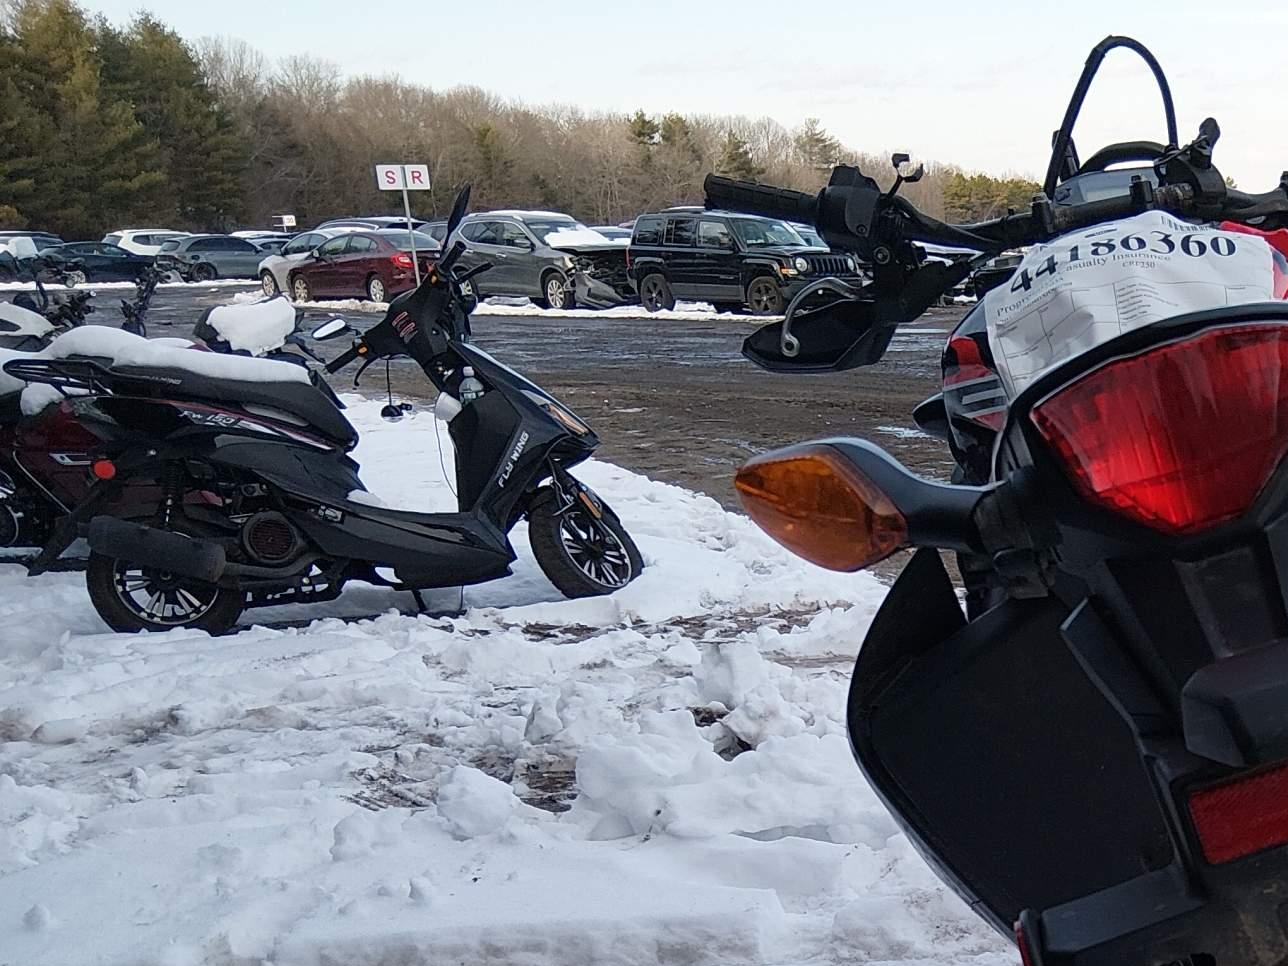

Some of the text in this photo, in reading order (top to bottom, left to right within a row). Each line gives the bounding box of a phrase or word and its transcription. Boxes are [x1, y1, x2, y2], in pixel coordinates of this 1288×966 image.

[385, 170, 424, 185] S R
[1010, 230, 1237, 294] 44186360
[1066, 256, 1108, 272] asualty
[498, 430, 530, 488] FLY WING
